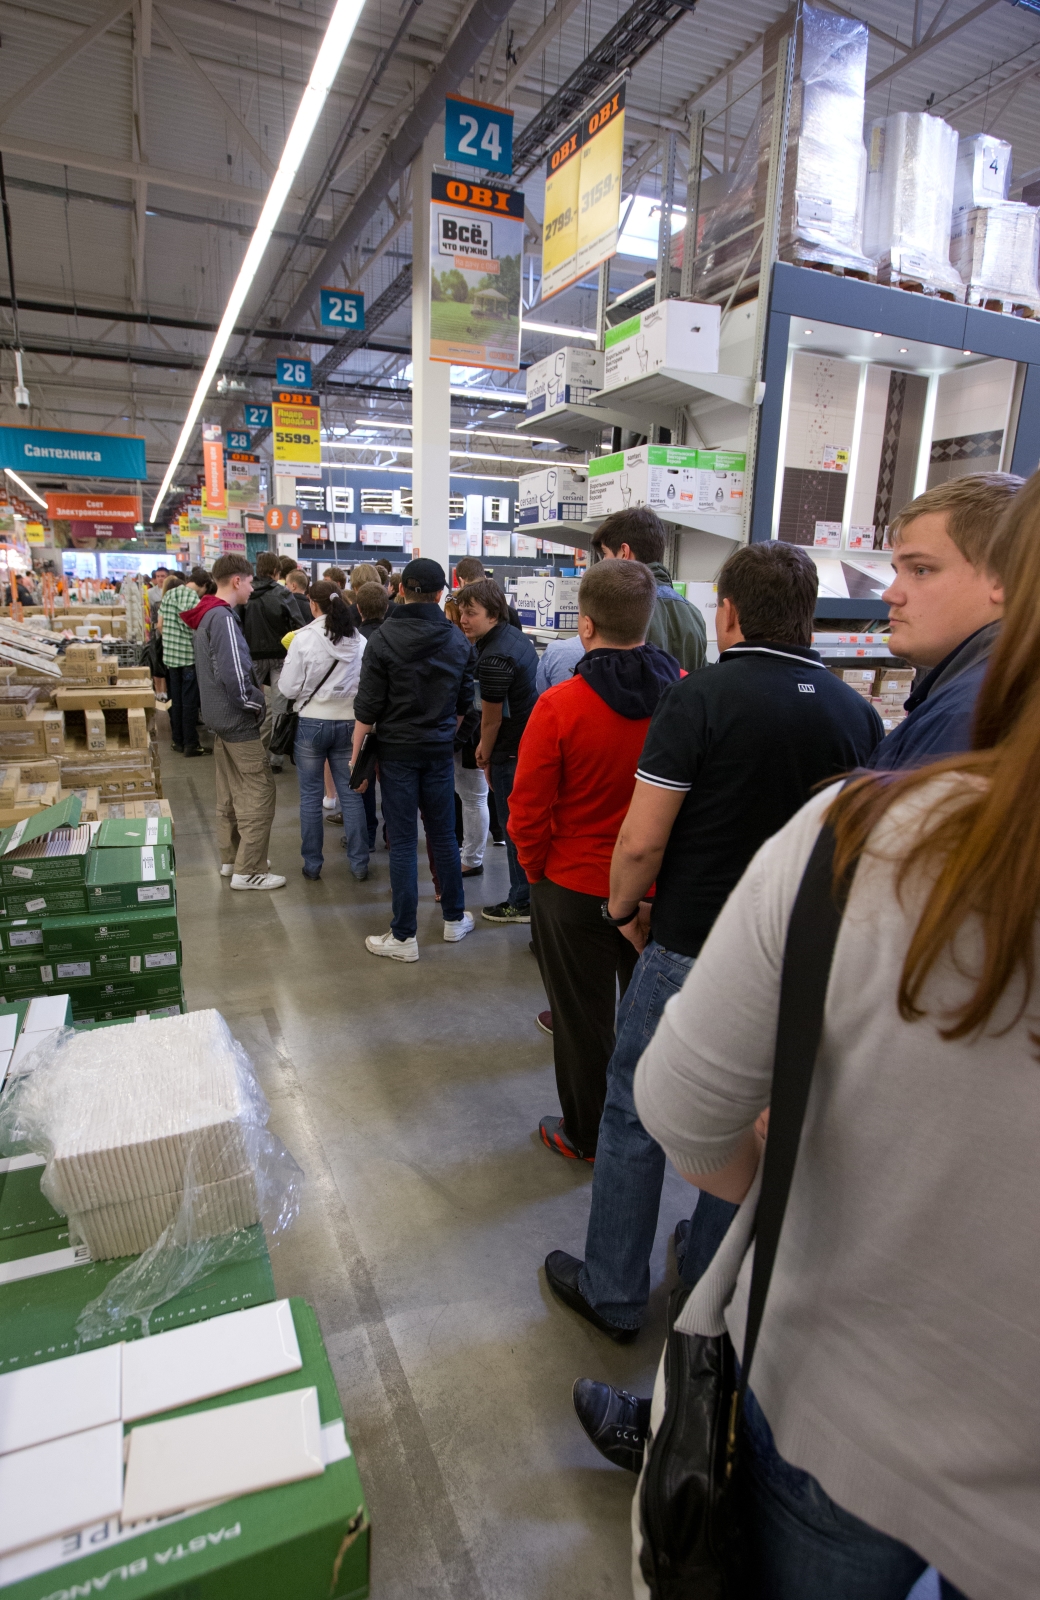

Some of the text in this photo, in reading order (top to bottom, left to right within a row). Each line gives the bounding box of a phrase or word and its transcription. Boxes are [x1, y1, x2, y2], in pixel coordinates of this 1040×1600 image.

[588, 92, 620, 134] OBI
[458, 114, 502, 162] 24
[551, 133, 578, 170] OBI
[989, 159, 998, 174] 4
[446, 180, 510, 212] OBI
[442, 218, 488, 248] Всё,
[442, 242, 488, 256] что нужно
[328, 296, 358, 323] 25
[283, 362, 306, 382] 26
[278, 392, 312, 405] OBI
[250, 408, 268, 423] 27
[231, 434, 248, 447] 28
[276, 432, 318, 444] 5599.-
[24, 444, 102, 462] Сантехника
[232, 453, 254, 462] OBI
[86, 500, 104, 508] Свет
[520, 494, 538, 506] cersanit
[56, 508, 135, 518] Электроинсталляция
[518, 598, 536, 608] cersanit
[154, 1522, 242, 1565] PASTA
